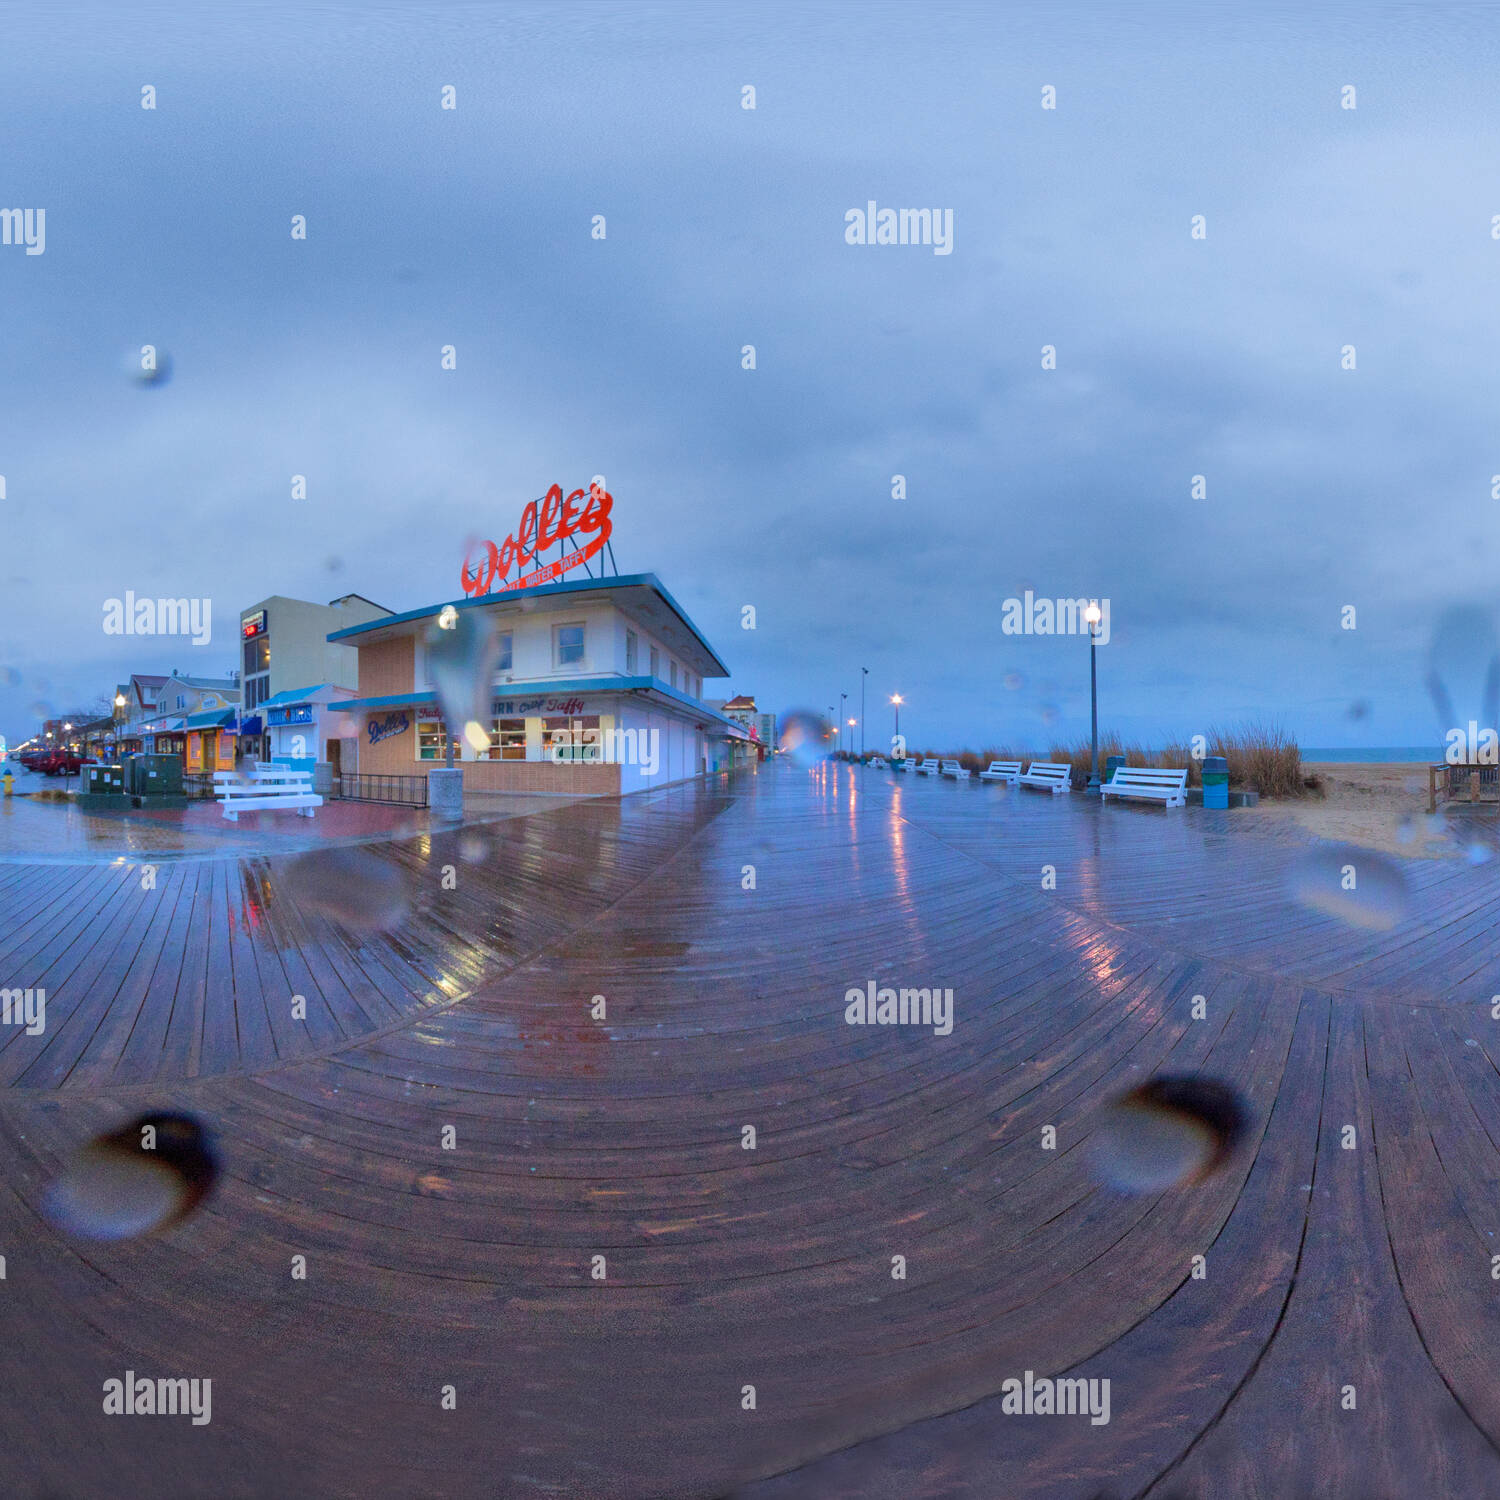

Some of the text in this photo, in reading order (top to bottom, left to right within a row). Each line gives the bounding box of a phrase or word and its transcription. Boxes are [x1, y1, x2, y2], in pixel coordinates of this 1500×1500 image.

[526, 567, 553, 586] WATER
[558, 547, 587, 572] TAFFY
[546, 697, 584, 715] Taffy
